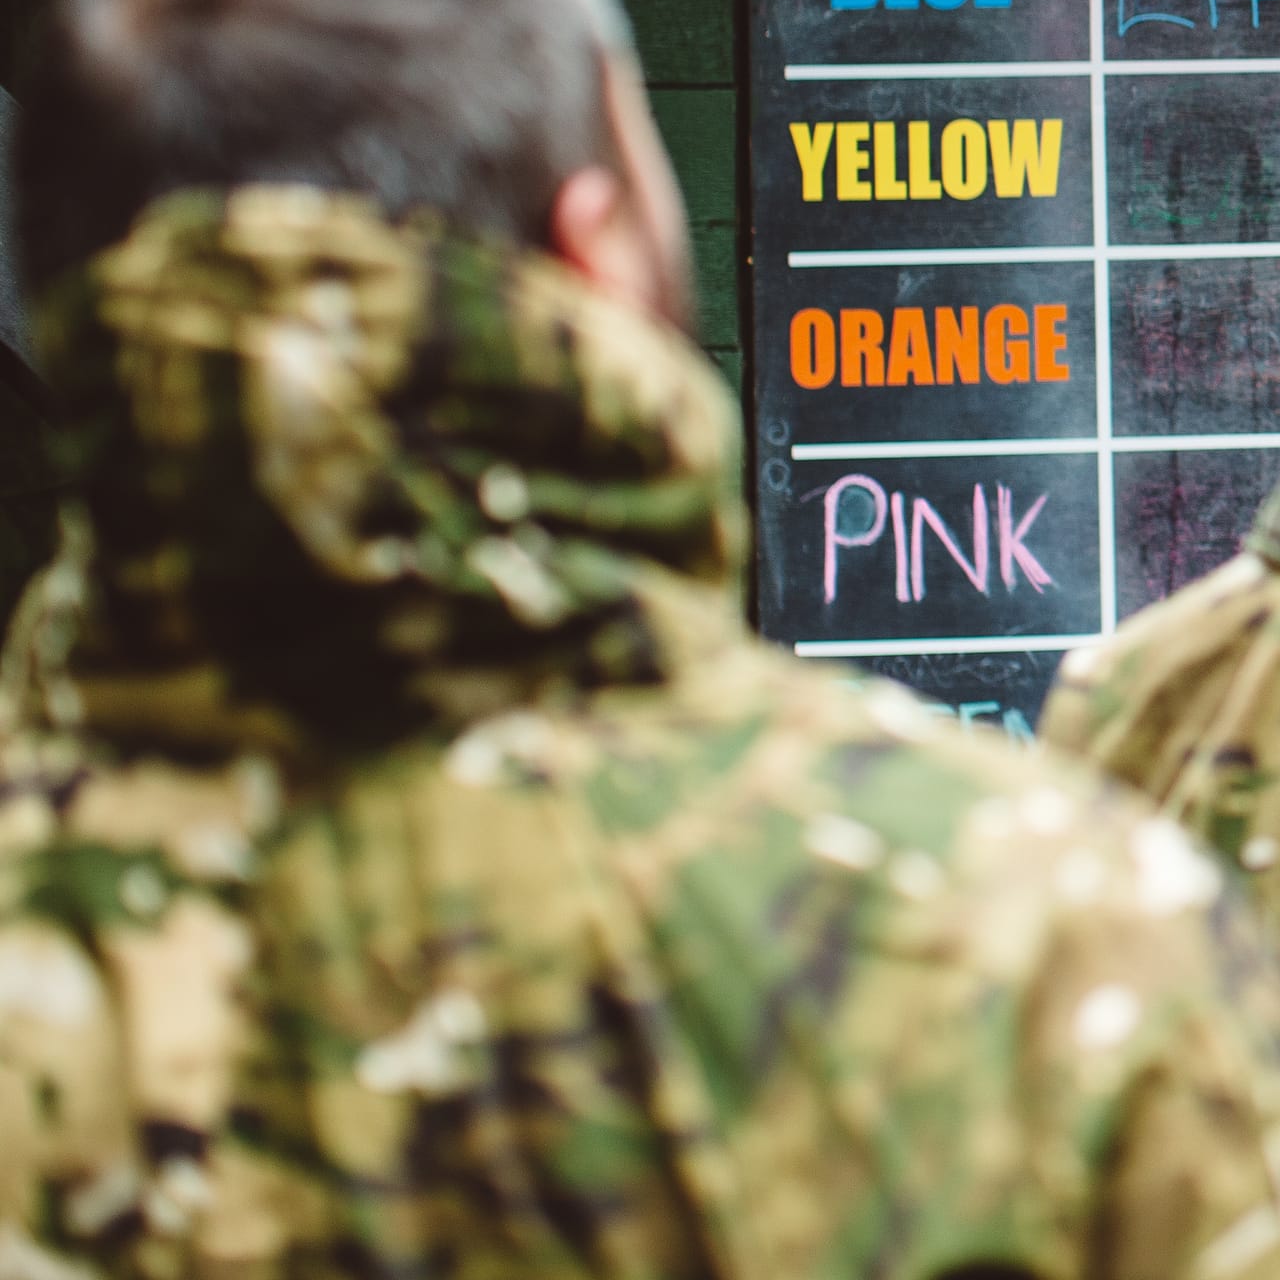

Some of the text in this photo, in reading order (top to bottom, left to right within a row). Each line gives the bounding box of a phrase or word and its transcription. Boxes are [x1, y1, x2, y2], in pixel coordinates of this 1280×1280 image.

[788, 117, 1064, 202] YELLOW
[789, 303, 1071, 391] ORANGE
[823, 473, 1055, 605] PINK
